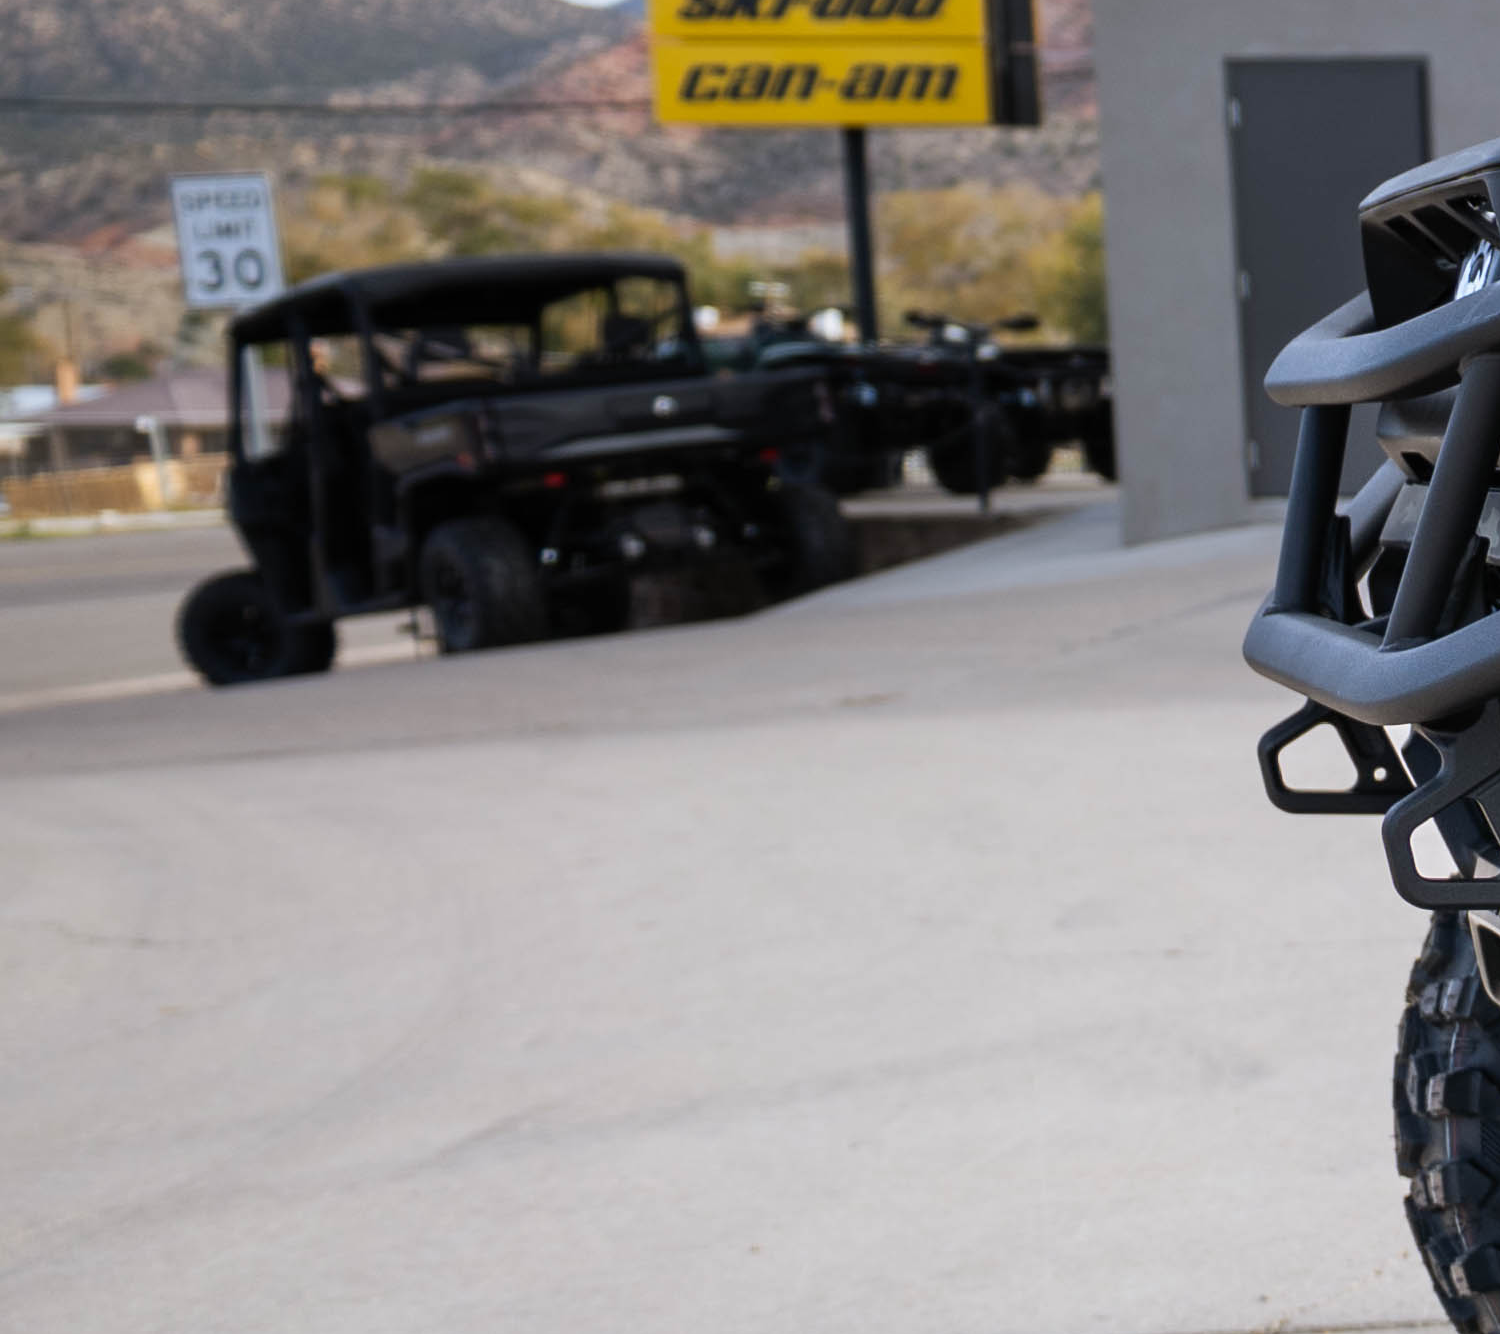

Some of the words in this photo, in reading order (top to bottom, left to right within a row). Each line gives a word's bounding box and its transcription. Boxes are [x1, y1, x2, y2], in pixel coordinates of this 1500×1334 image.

[679, 61, 960, 103] can-am
[179, 189, 262, 212] SPEED
[191, 219, 257, 240] LIMIT
[197, 249, 266, 292] 30
